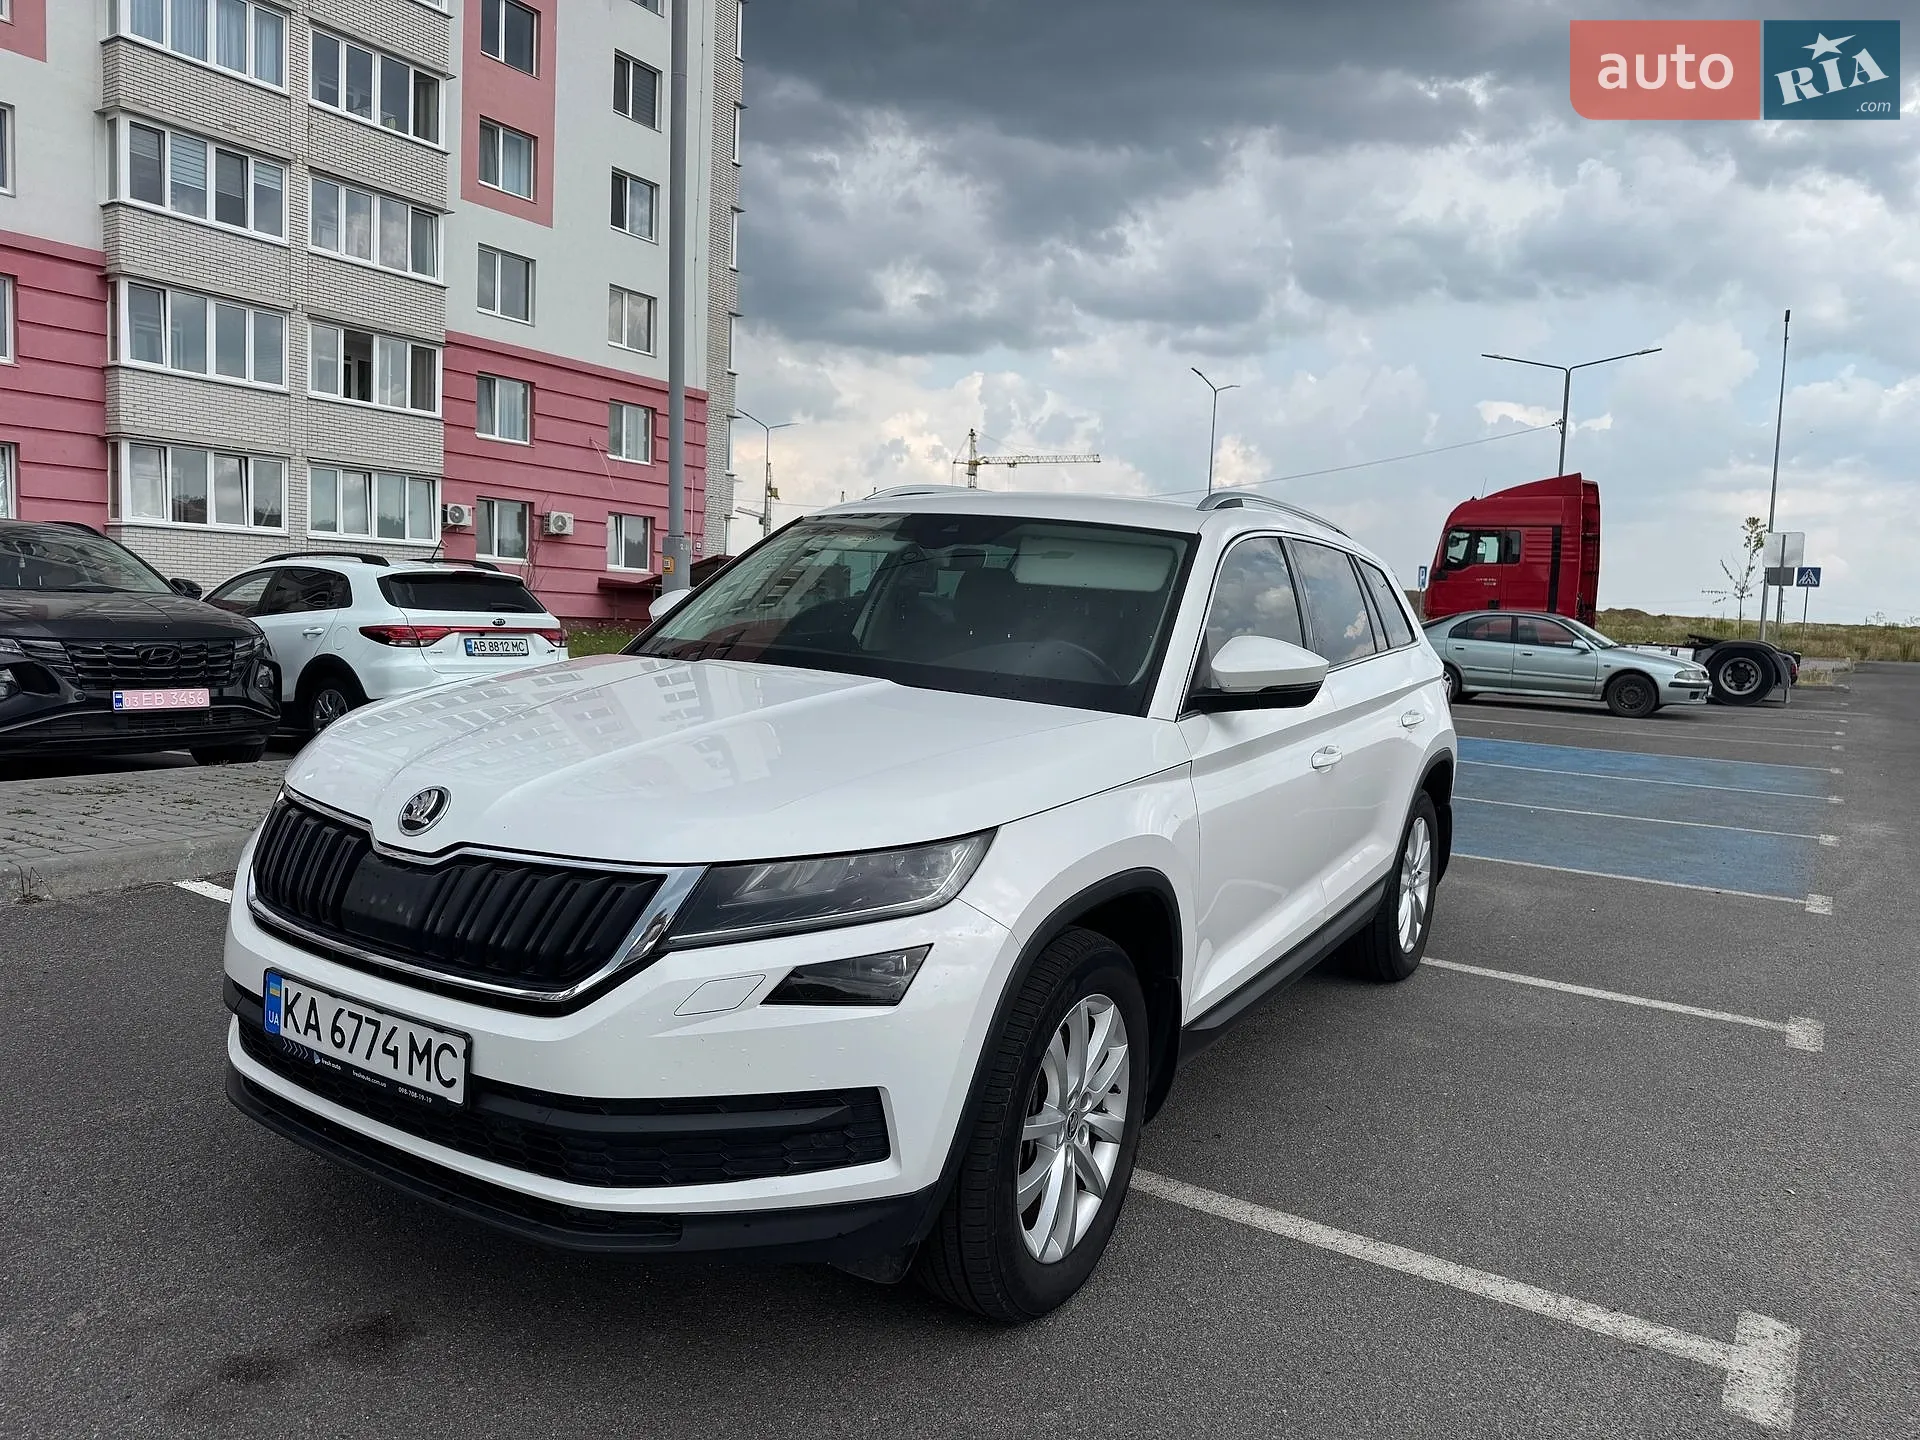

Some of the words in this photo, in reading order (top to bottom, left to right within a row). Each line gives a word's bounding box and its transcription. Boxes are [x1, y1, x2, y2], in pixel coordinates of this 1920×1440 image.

[473, 641, 487, 652] AB
[489, 641, 511, 652] 8812
[512, 641, 525, 652] MC
[142, 692, 165, 706] EB
[170, 691, 205, 705] 3456
[268, 1010, 280, 1027] UA
[283, 987, 322, 1042] KA
[331, 1008, 399, 1070] 6774
[408, 1031, 458, 1089] MC
